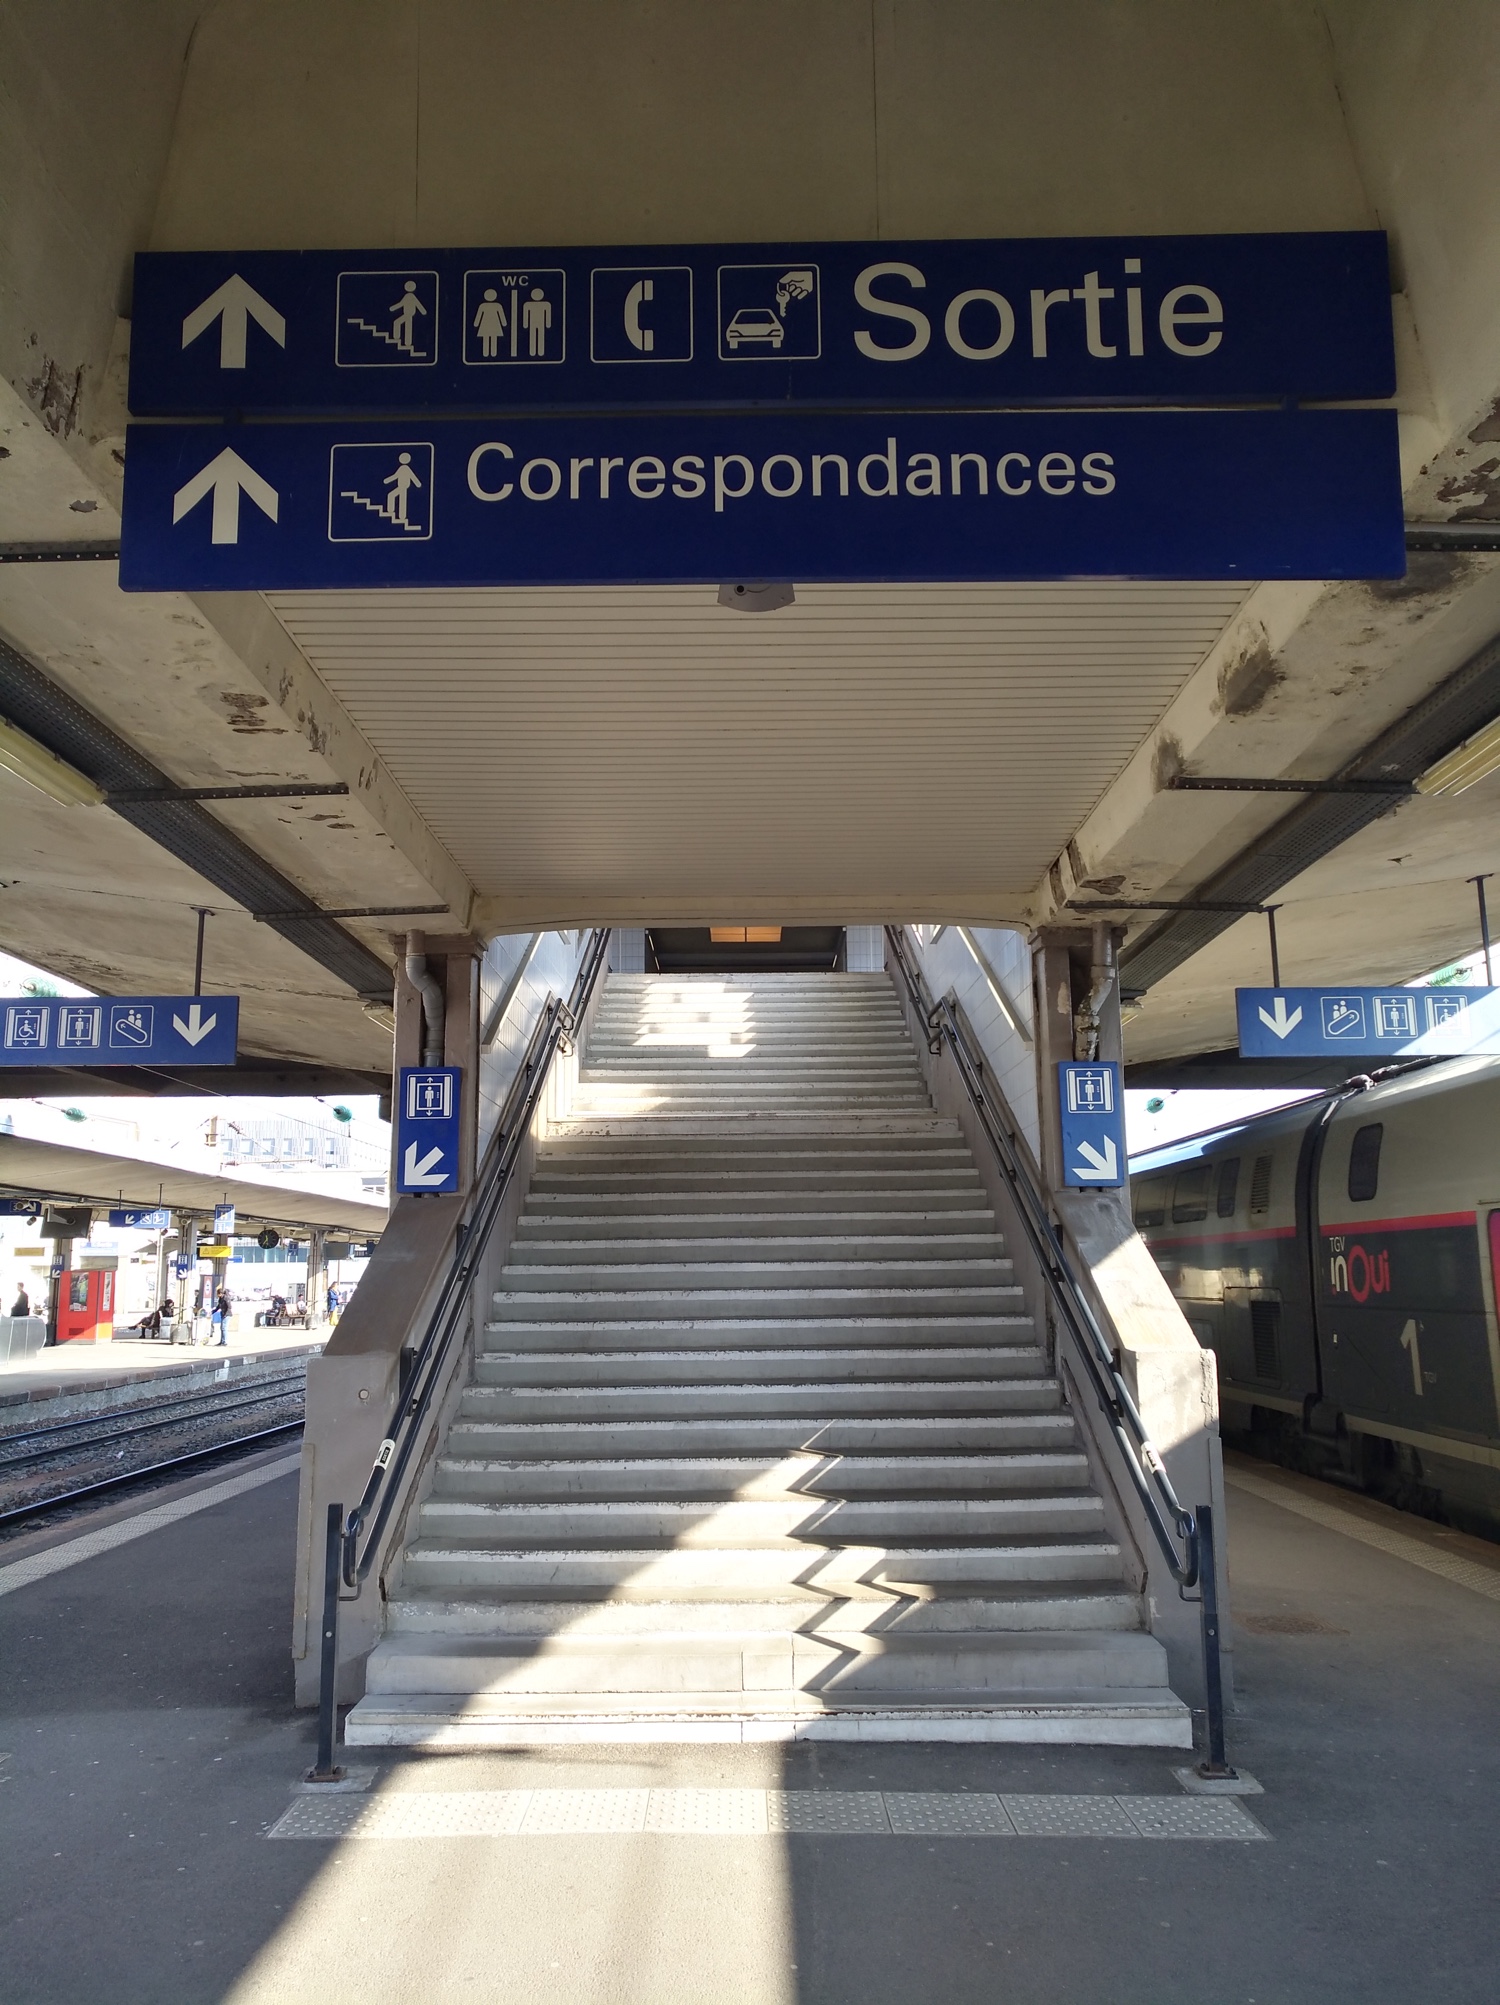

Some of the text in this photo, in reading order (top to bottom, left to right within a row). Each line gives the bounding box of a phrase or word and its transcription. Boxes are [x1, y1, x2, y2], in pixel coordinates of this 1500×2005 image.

[502, 275, 529, 287] WC
[853, 258, 1224, 362] Sortie
[467, 437, 1116, 513] Correspondances
[1329, 1236, 1346, 1252] TGV
[1399, 1318, 1424, 1396] 1
